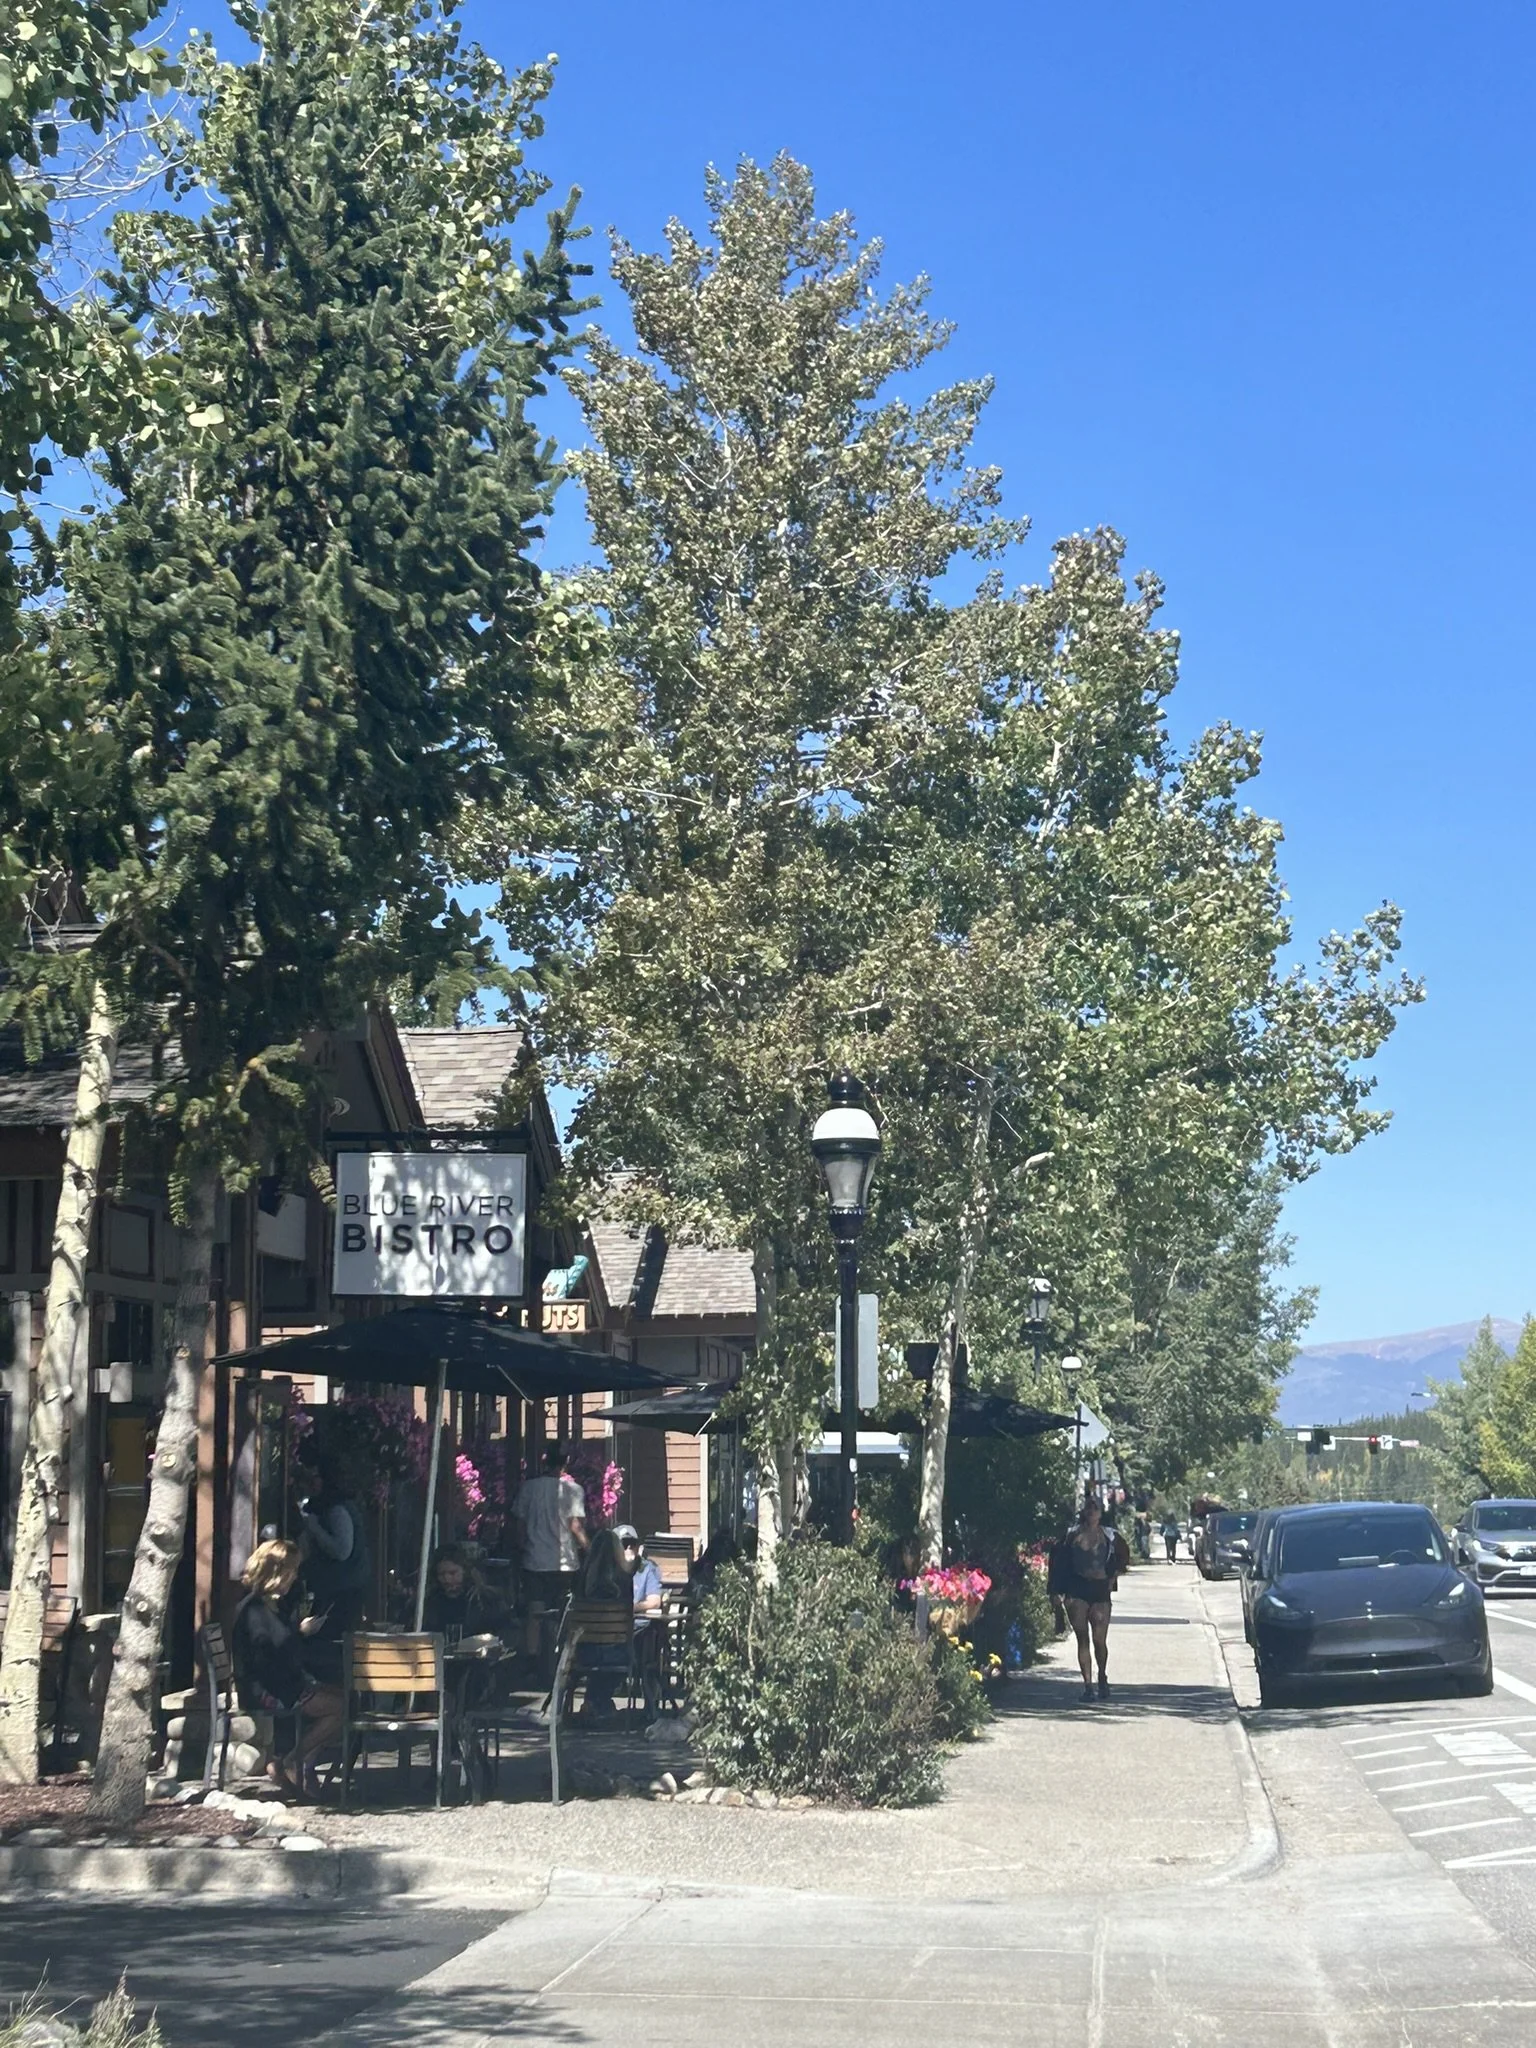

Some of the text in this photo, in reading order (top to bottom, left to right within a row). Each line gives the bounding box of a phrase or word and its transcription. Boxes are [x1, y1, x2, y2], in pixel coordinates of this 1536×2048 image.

[343, 1194, 514, 1217] BLUE RIVER
[342, 1223, 514, 1256] BISTRO
